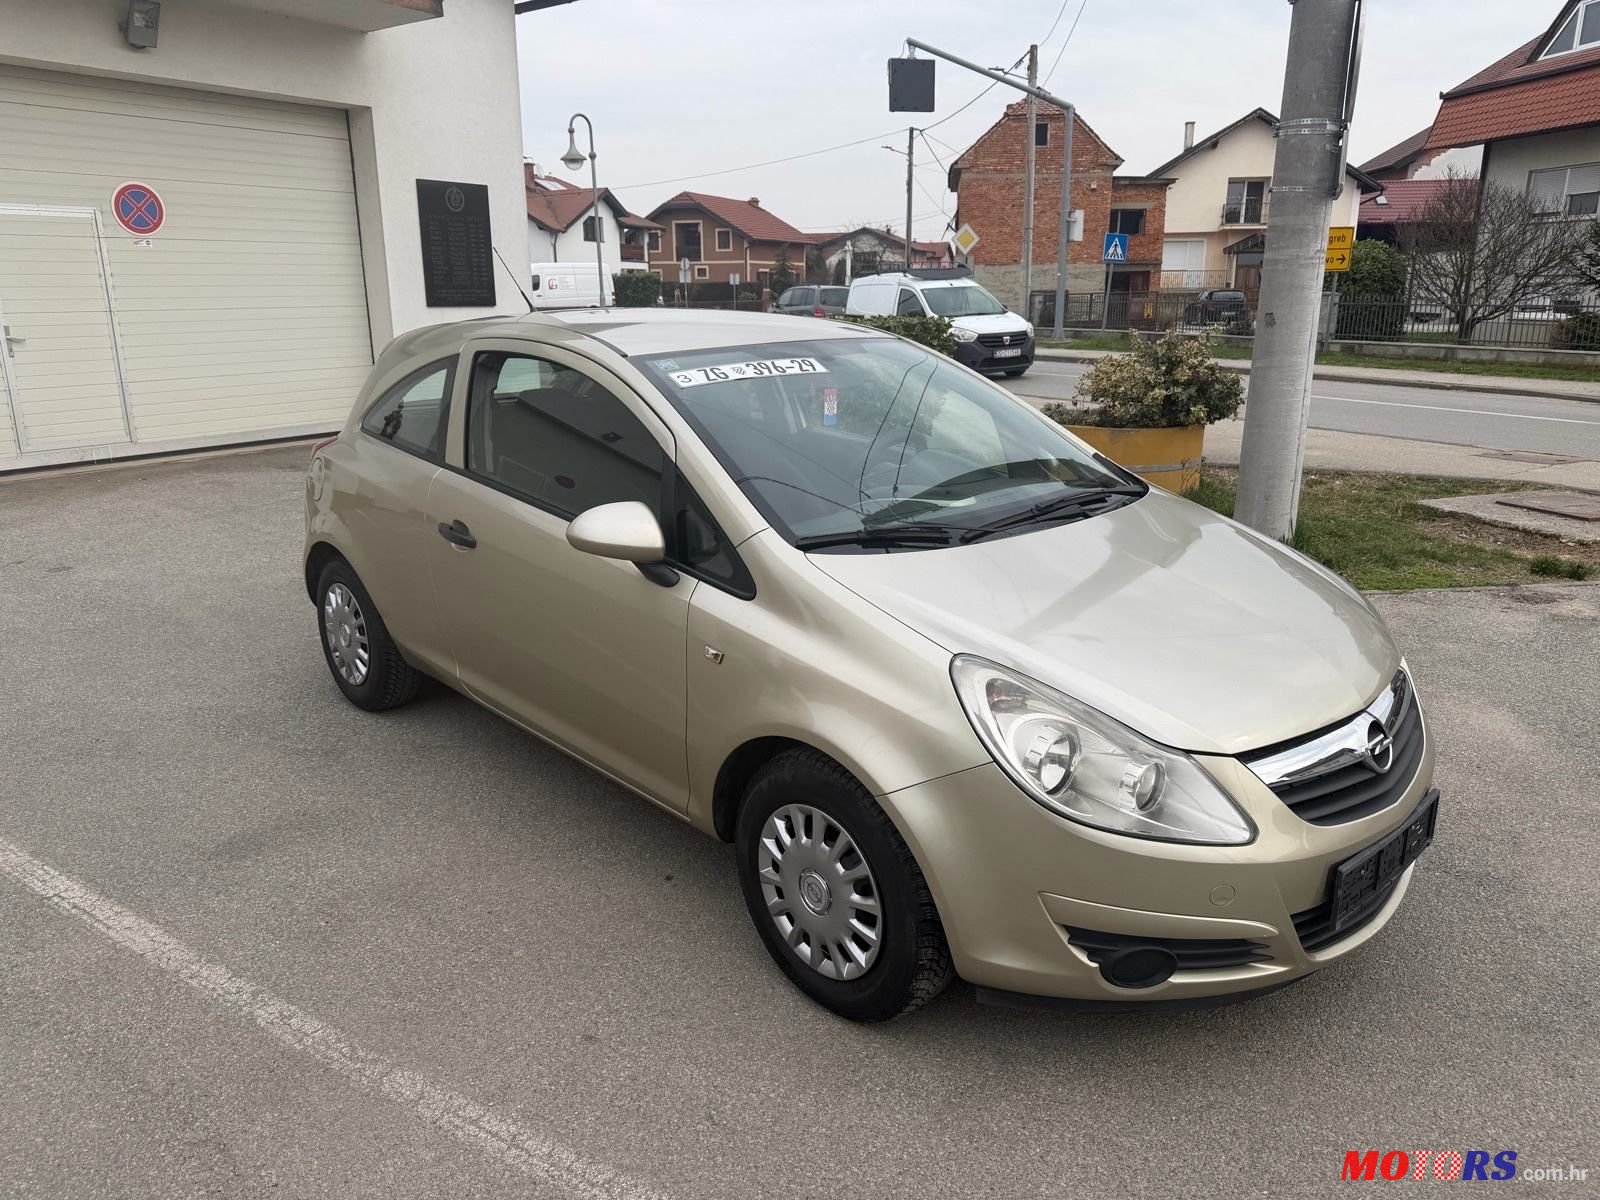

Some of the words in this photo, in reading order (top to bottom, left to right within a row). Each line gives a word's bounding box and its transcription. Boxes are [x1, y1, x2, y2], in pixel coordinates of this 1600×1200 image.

[1328, 233, 1345, 245] greb
[676, 374, 692, 384] 3
[697, 367, 729, 382] ZG
[746, 359, 816, 375] 396-29
